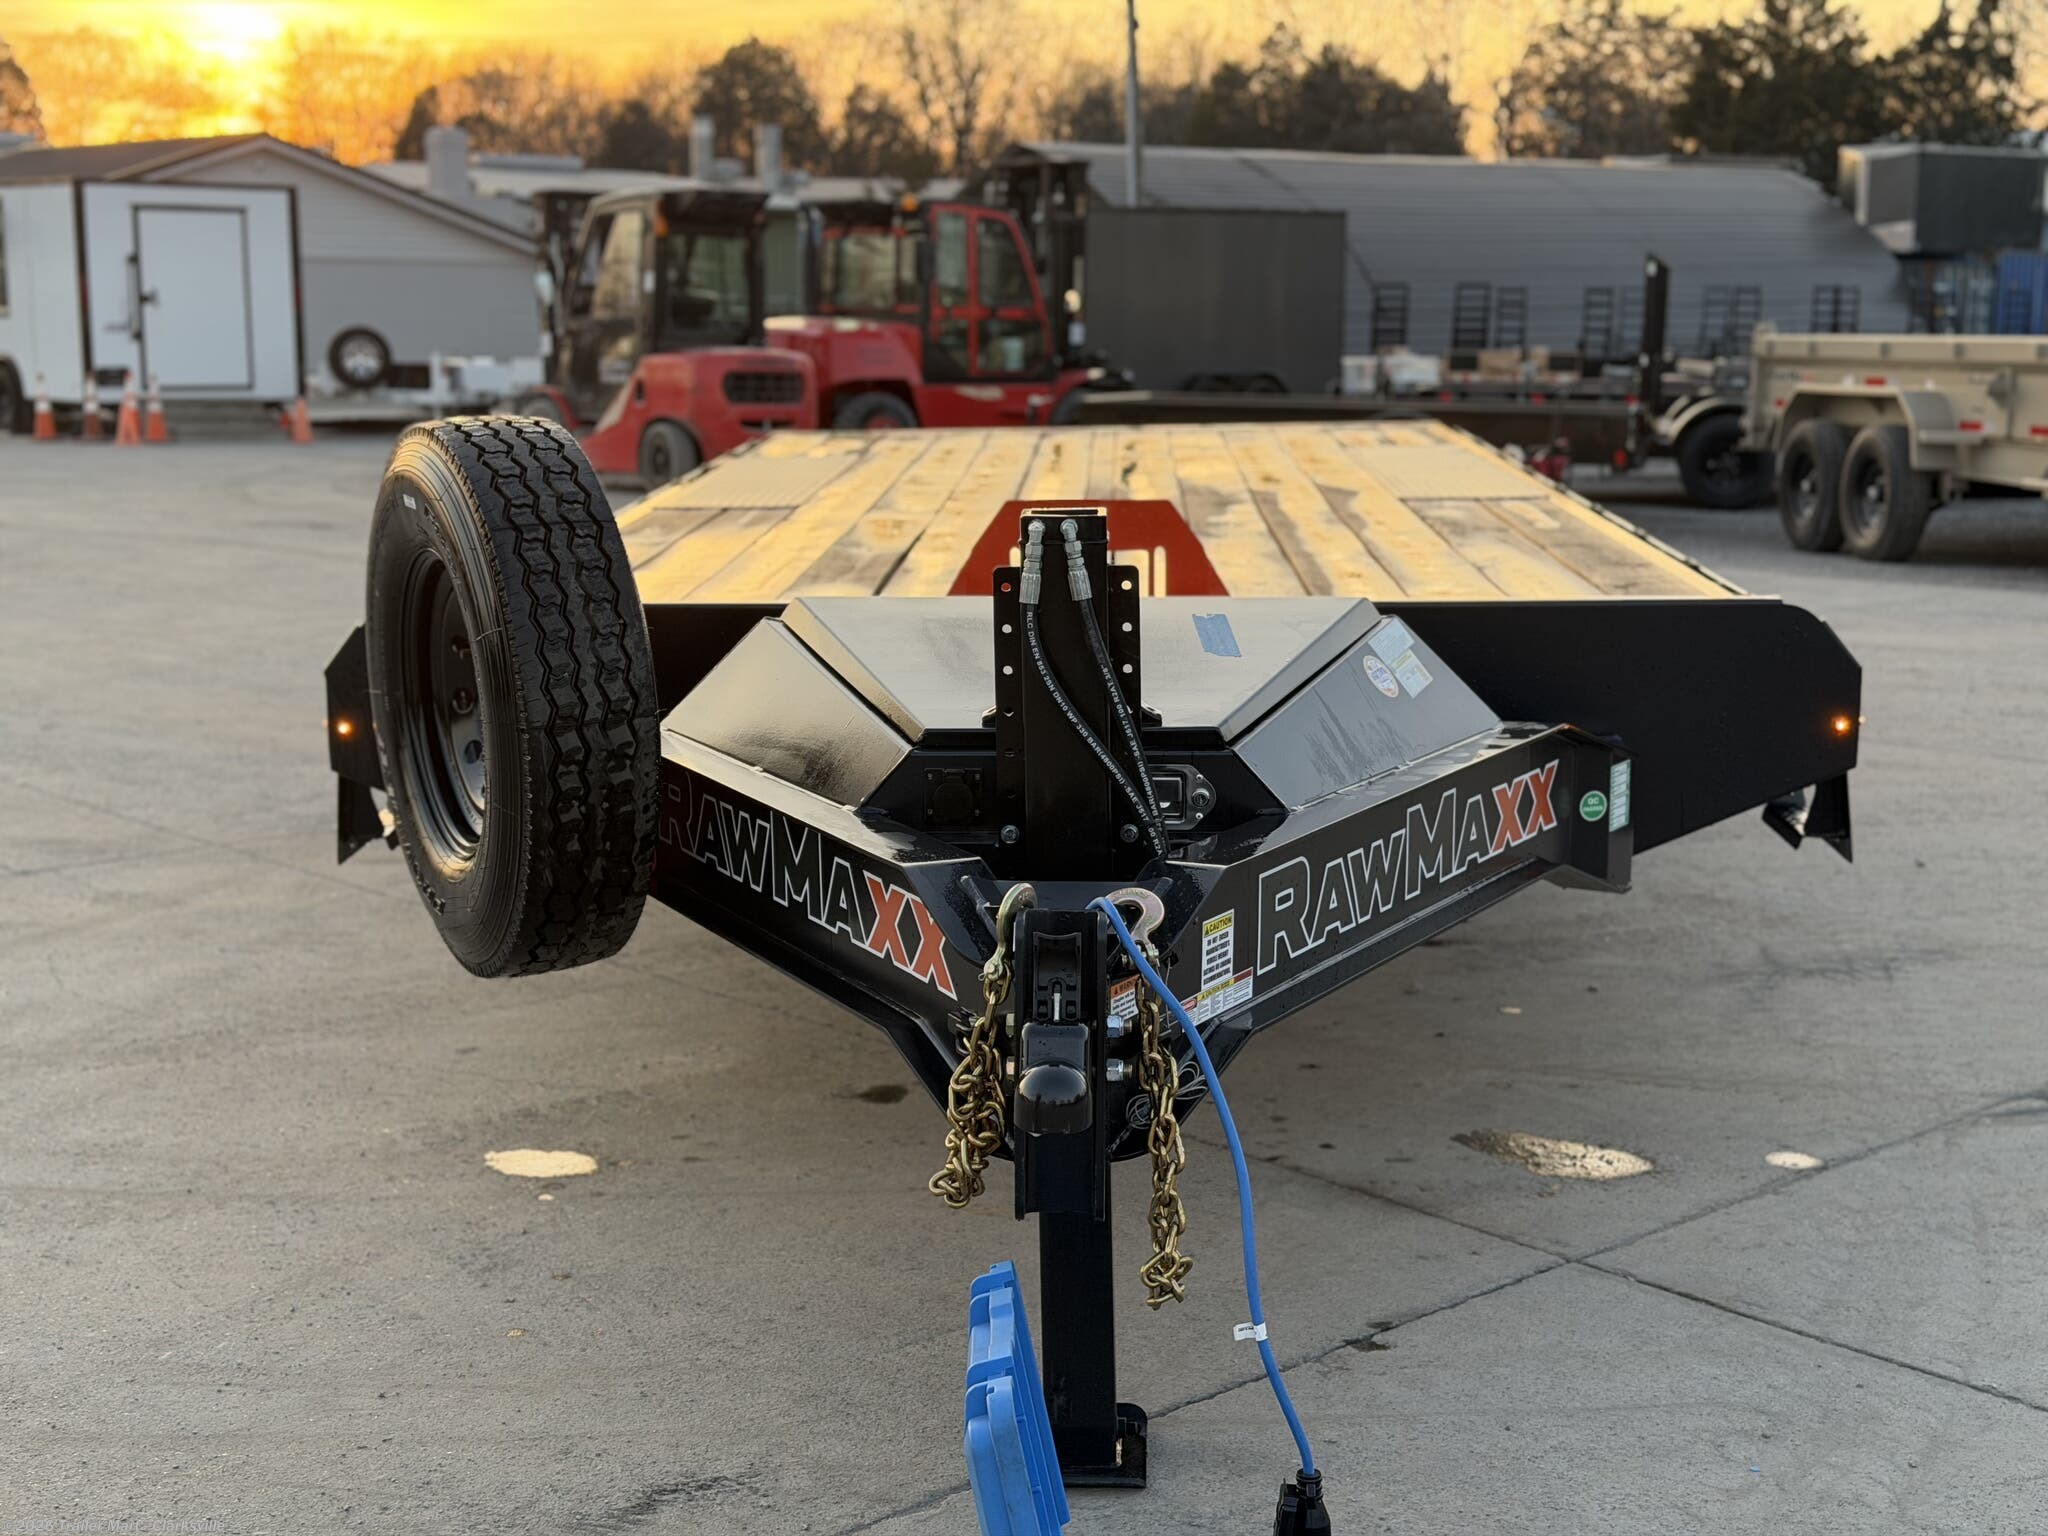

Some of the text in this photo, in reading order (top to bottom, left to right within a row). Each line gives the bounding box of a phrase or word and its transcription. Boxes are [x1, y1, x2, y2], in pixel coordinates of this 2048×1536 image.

[1028, 631, 1038, 647] DIN
[1032, 648, 1041, 660] EN
[1036, 660, 1047, 675] 853
[1043, 675, 1056, 692] 2SN
[1106, 681, 1121, 704] R2AT
[1053, 691, 1069, 711] DN10
[1066, 710, 1079, 724] WP
[1116, 703, 1127, 718] 100
[1076, 724, 1089, 738] 330
[1121, 720, 1134, 739] J517
[1587, 797, 1600, 805] QC
[1135, 803, 1150, 821] J517
[1209, 917, 1232, 932] CAUTION
